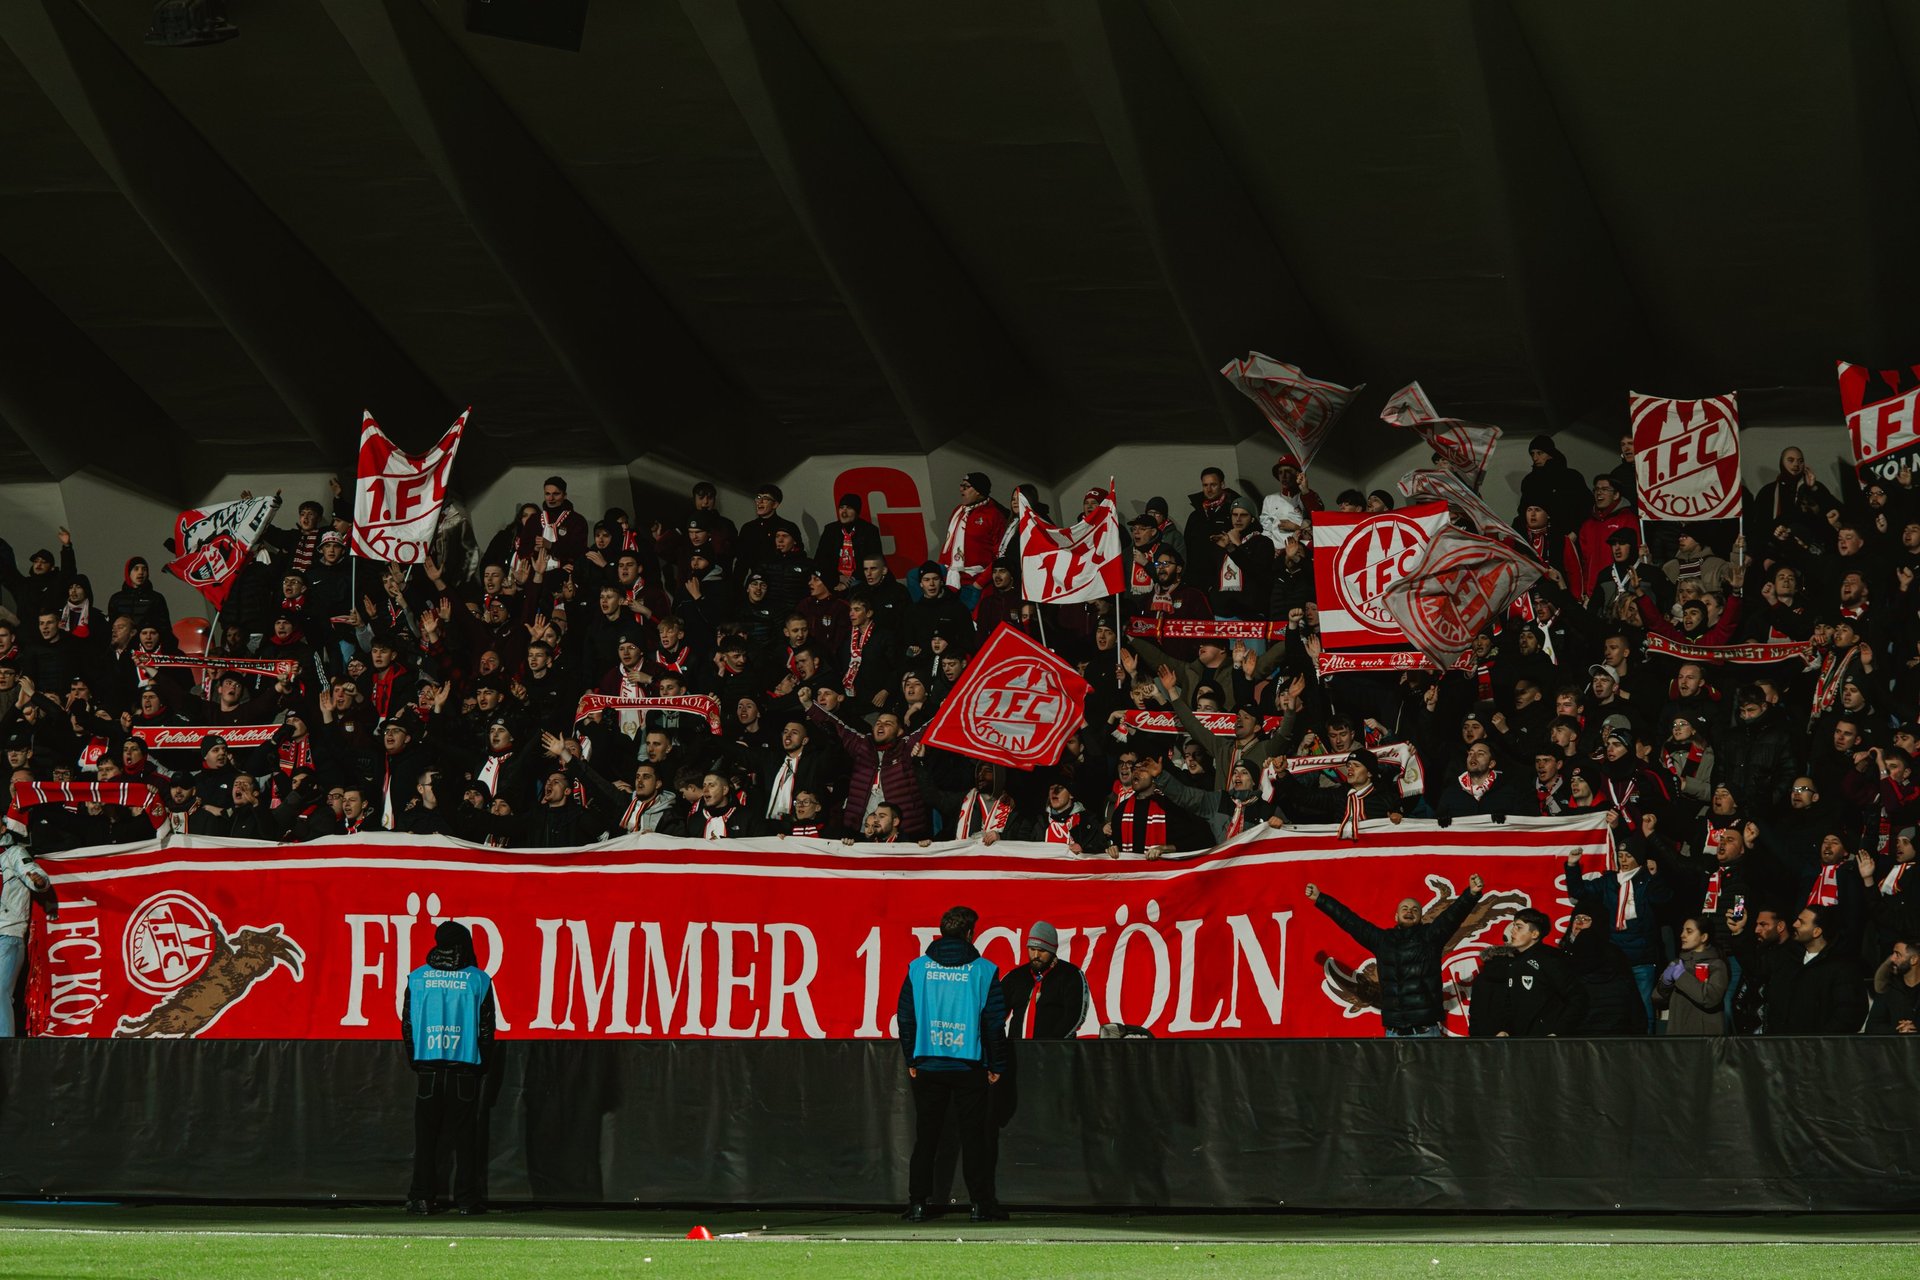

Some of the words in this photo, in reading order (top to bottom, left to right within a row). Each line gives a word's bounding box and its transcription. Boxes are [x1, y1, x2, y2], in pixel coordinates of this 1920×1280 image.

[1643, 423, 1718, 487] 1.FC
[1650, 486, 1722, 516] KÖLN
[834, 466, 928, 578] G
[1354, 549, 1416, 605] 1.FC
[982, 691, 1055, 722] 1.FC
[339, 892, 511, 1032] FÜR
[528, 918, 828, 1039] IMMER
[423, 970, 471, 980] SECURITY
[926, 971, 969, 982] SERVICE
[425, 979, 467, 990] SERVICE
[426, 1025, 461, 1034] STEWARD
[427, 1034, 460, 1050] 0107
